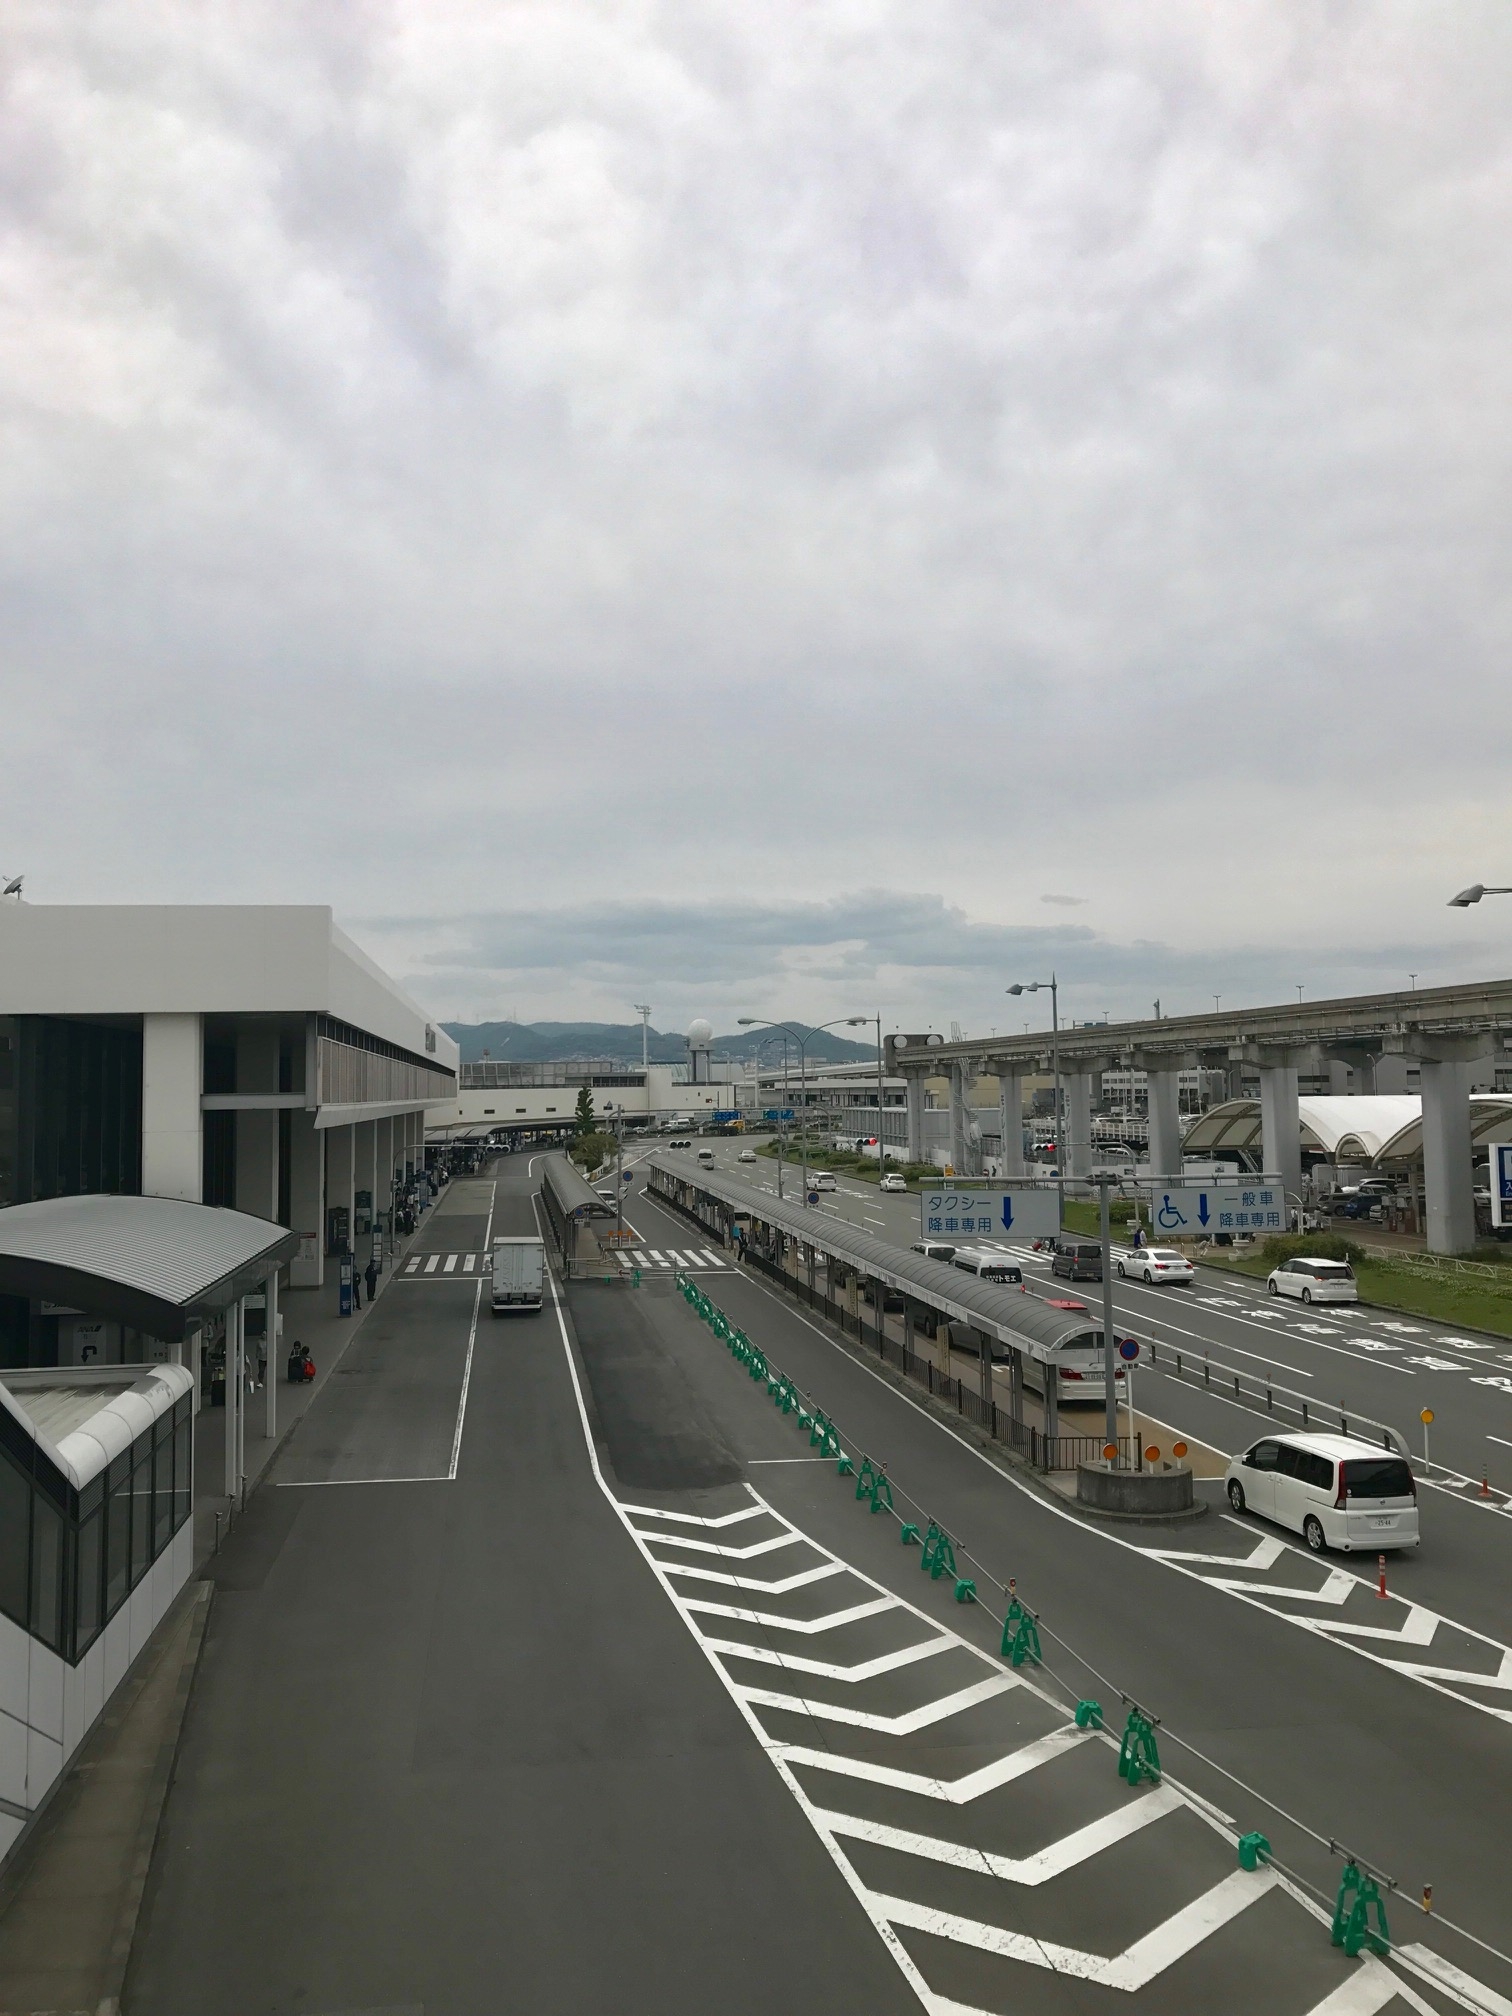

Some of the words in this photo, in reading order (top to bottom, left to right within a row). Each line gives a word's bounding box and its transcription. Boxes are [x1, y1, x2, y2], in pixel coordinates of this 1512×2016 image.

[928, 1196, 991, 1211] タクシー
[1224, 1191, 1274, 1207] 一般車
[928, 1217, 992, 1233] 降車専用
[1220, 1212, 1280, 1228] 降車専用
